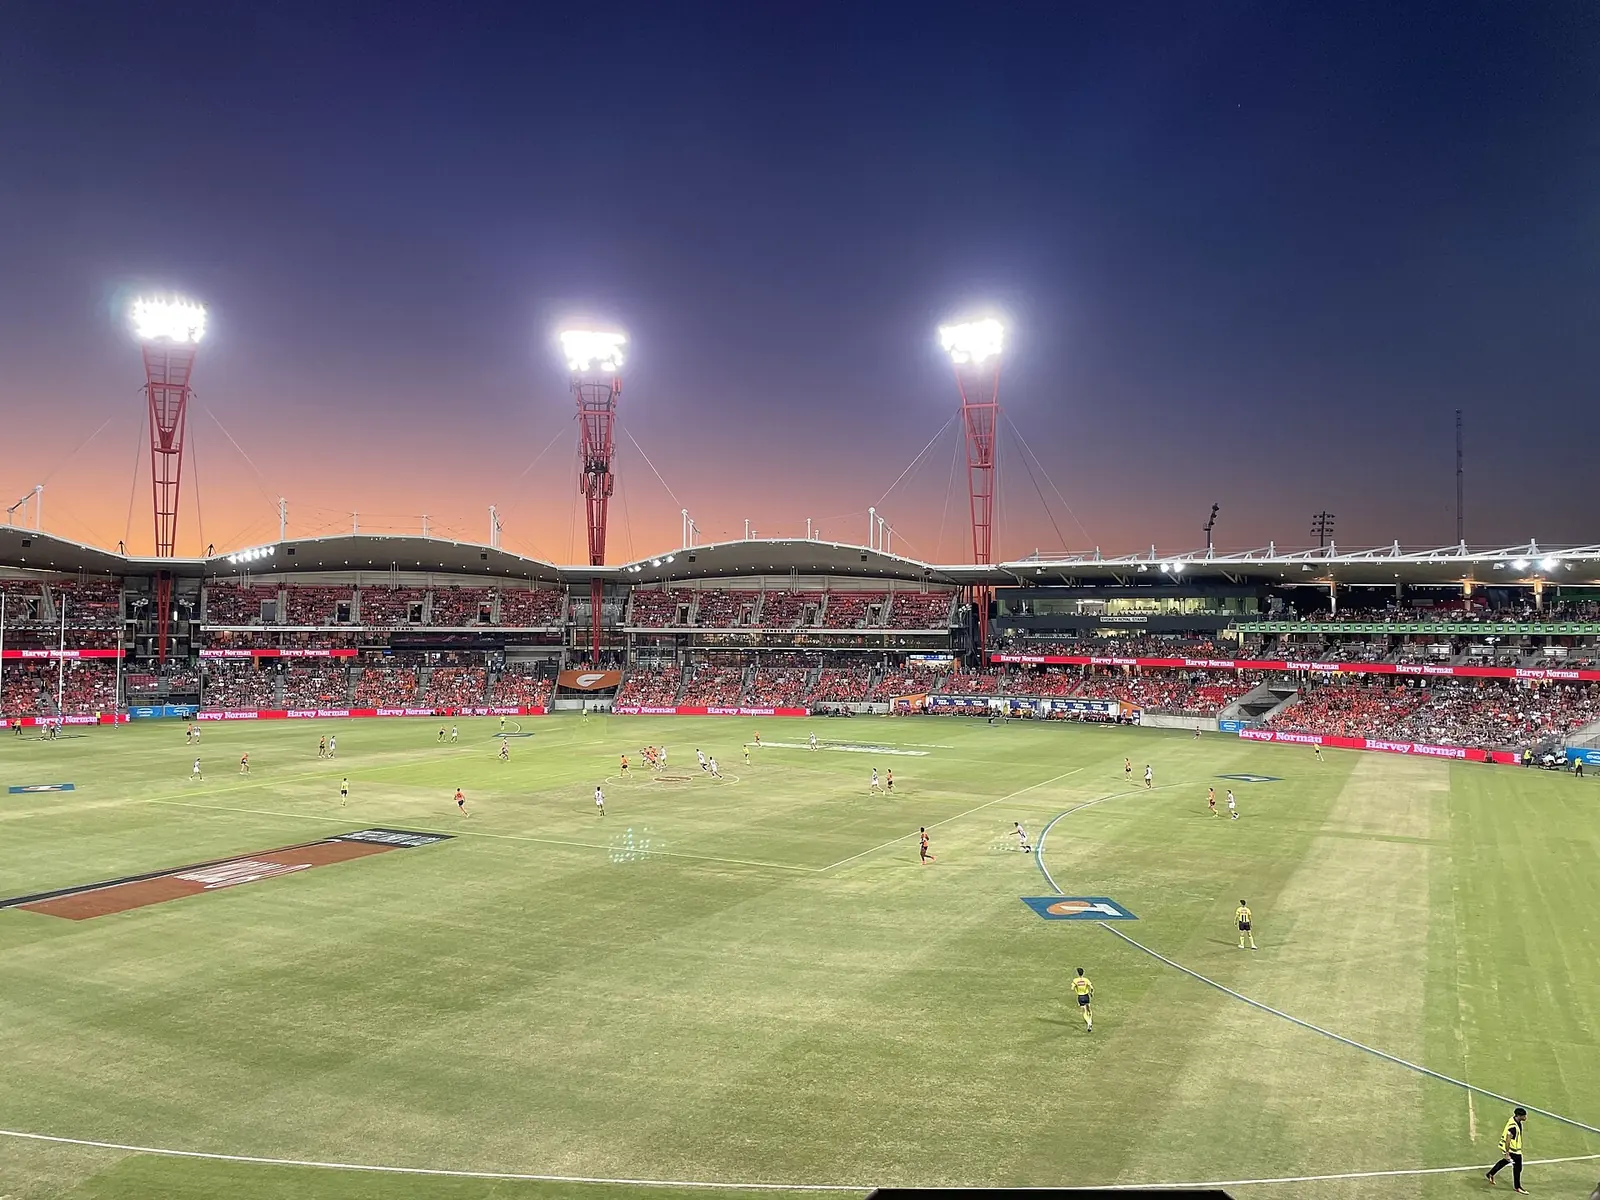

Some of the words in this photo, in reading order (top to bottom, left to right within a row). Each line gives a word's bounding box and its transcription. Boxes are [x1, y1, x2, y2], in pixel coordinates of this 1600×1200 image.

[1287, 662, 1310, 670] Harvey
[1312, 662, 1339, 670] Norman
[1396, 665, 1423, 674] Harvey
[1423, 666, 1453, 674] Norman
[1516, 669, 1545, 678] Harvey
[1547, 670, 1579, 678] Norman
[376, 708, 404, 716] Harvey
[462, 707, 488, 715] Havey
[66, 715, 97, 723] Norman
[1275, 732, 1322, 743] Norman
[1365, 740, 1411, 753] Harvey
[1413, 743, 1465, 758] Norman
